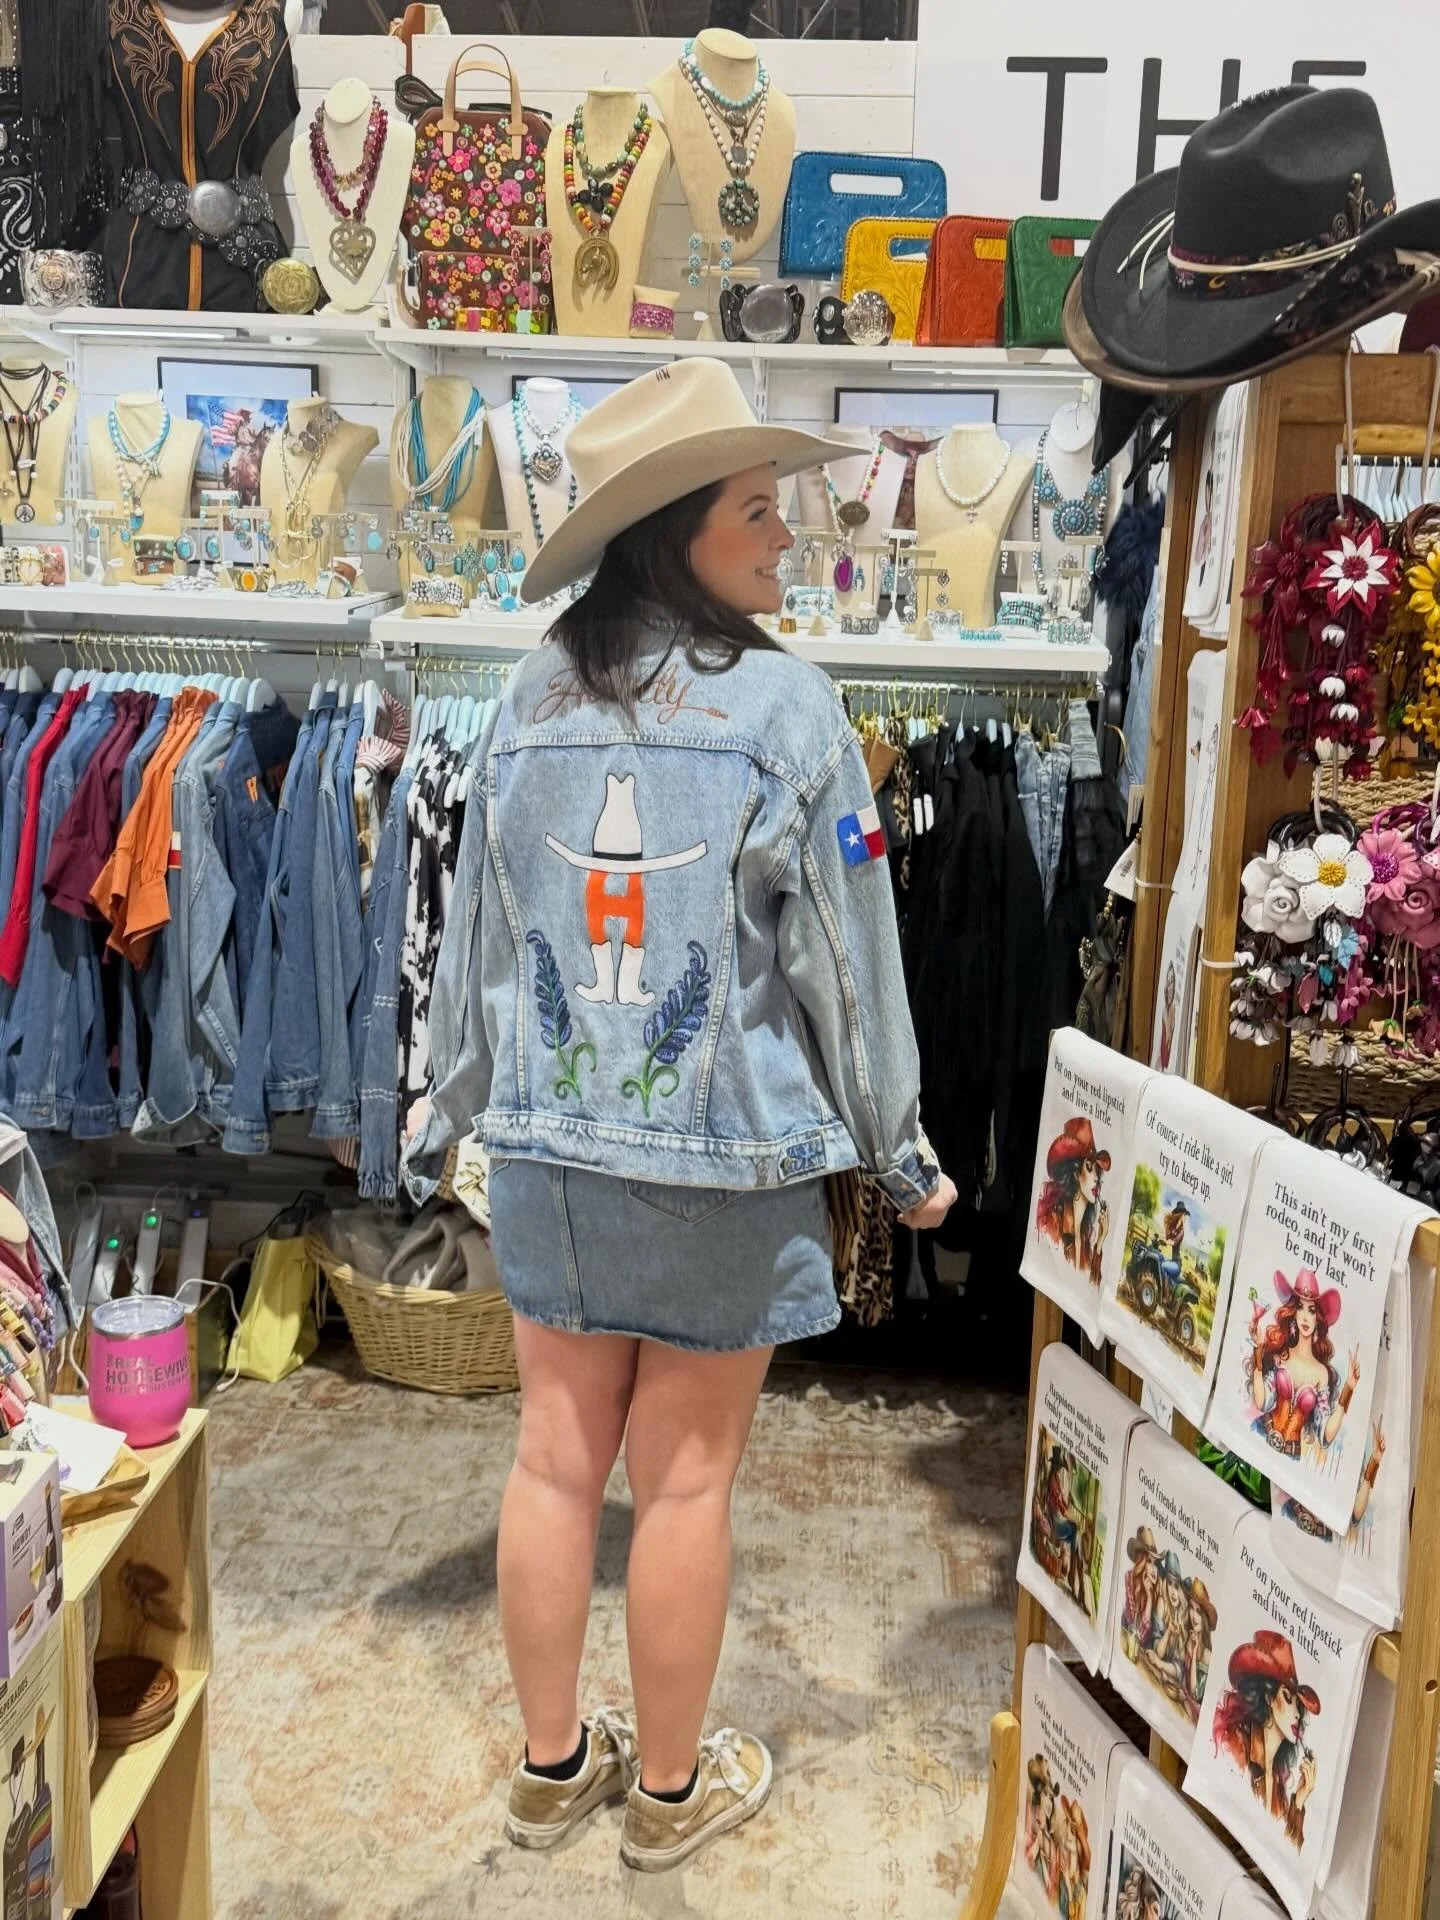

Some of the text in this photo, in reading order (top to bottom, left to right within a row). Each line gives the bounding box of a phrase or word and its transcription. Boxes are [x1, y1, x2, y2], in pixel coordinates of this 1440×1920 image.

[1054, 1055, 1125, 1115] Put on your red lipstick
[1061, 1087, 1074, 1102] and
[1075, 1090, 1088, 1111] live
[1089, 1104, 1093, 1115] a
[1146, 1109, 1158, 1129] Of
[1156, 1121, 1178, 1146] course
[1179, 1132, 1184, 1150] I
[1184, 1137, 1200, 1160] ride
[1201, 1144, 1215, 1170] like
[1215, 1161, 1219, 1175] a
[1159, 1149, 1211, 1203] try to keep up.
[1265, 1204, 1376, 1282] rodeo, and it won't
[1274, 1181, 1376, 1258] This ain't my first
[1285, 1232, 1348, 1289] be my last.
[1049, 1381, 1076, 1416] Happiness
[1094, 1423, 1106, 1445] like
[1063, 1416, 1073, 1431] cut
[1074, 1420, 1086, 1445] hay,
[1087, 1434, 1109, 1466] bonfires
[1060, 1430, 1074, 1452] crisp
[1075, 1444, 1090, 1466] clean
[1090, 1459, 1100, 1476] air.
[1138, 1467, 1219, 1555] Good friends don't let you
[1140, 1491, 1149, 1510] do
[1150, 1504, 1169, 1530] stupid
[1240, 1544, 1343, 1660] Put on your red lipstick
[1252, 1588, 1320, 1664] and live a little.
